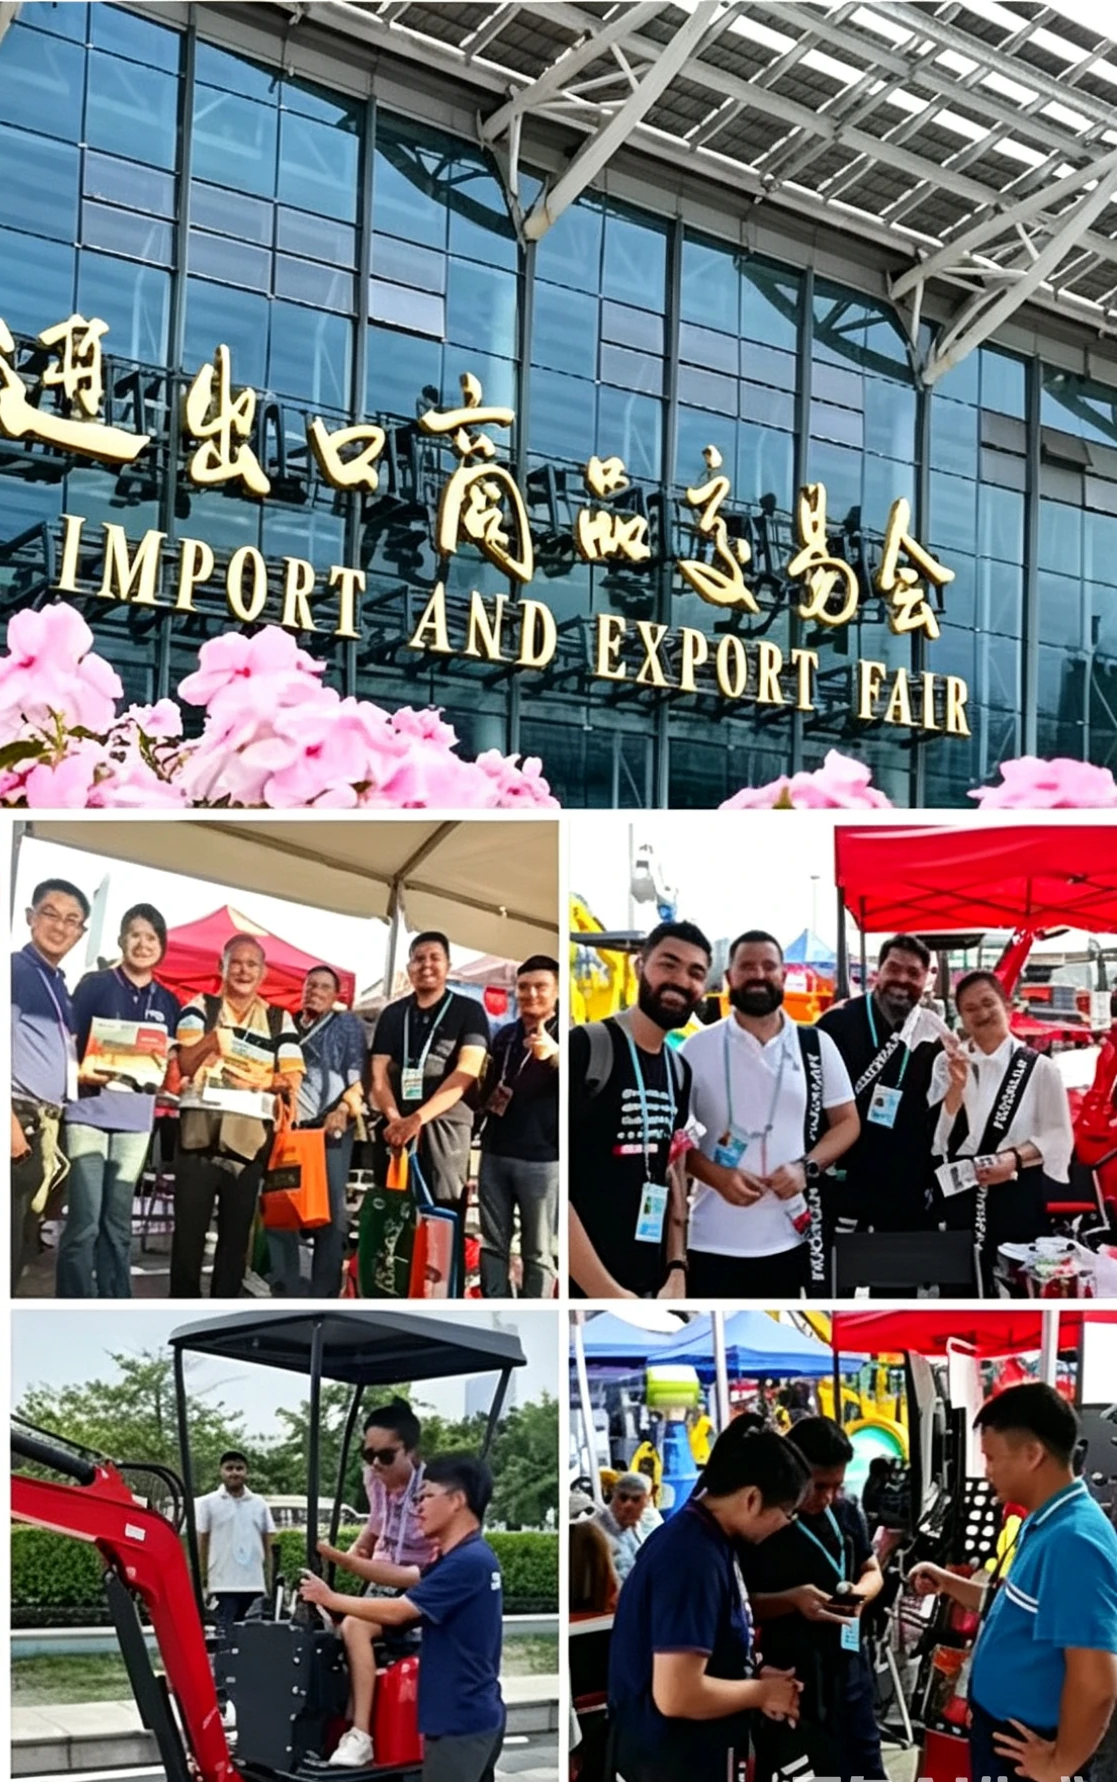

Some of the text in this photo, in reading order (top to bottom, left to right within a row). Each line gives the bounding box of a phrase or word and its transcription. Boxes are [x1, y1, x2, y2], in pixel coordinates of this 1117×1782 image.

[52, 514, 367, 640] IMPORT
[409, 582, 557, 670] AND
[595, 613, 819, 711] EXPORT
[858, 658, 972, 736] FAIR
